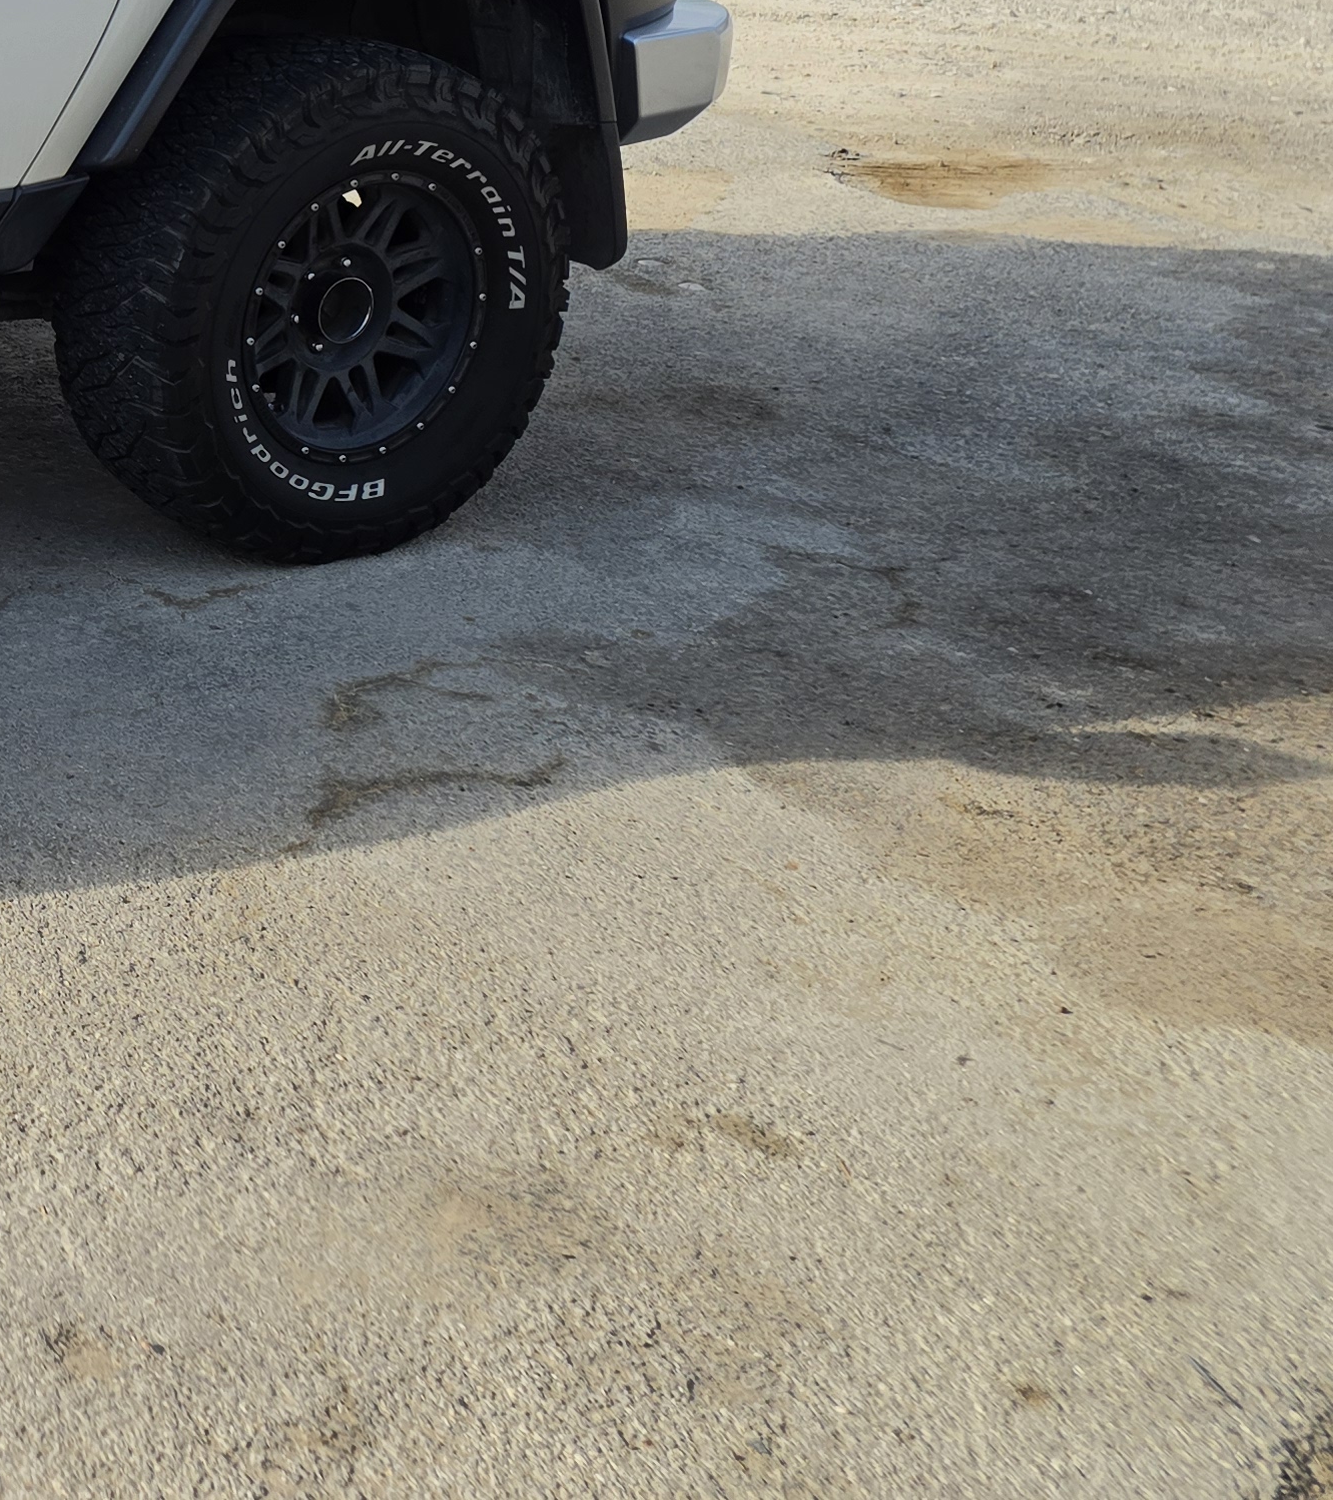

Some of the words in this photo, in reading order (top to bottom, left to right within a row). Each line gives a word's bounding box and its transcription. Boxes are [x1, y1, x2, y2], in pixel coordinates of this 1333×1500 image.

[349, 138, 517, 240] All-Terrain
[507, 244, 528, 311] T/A
[225, 359, 386, 502] BFGoodrich
